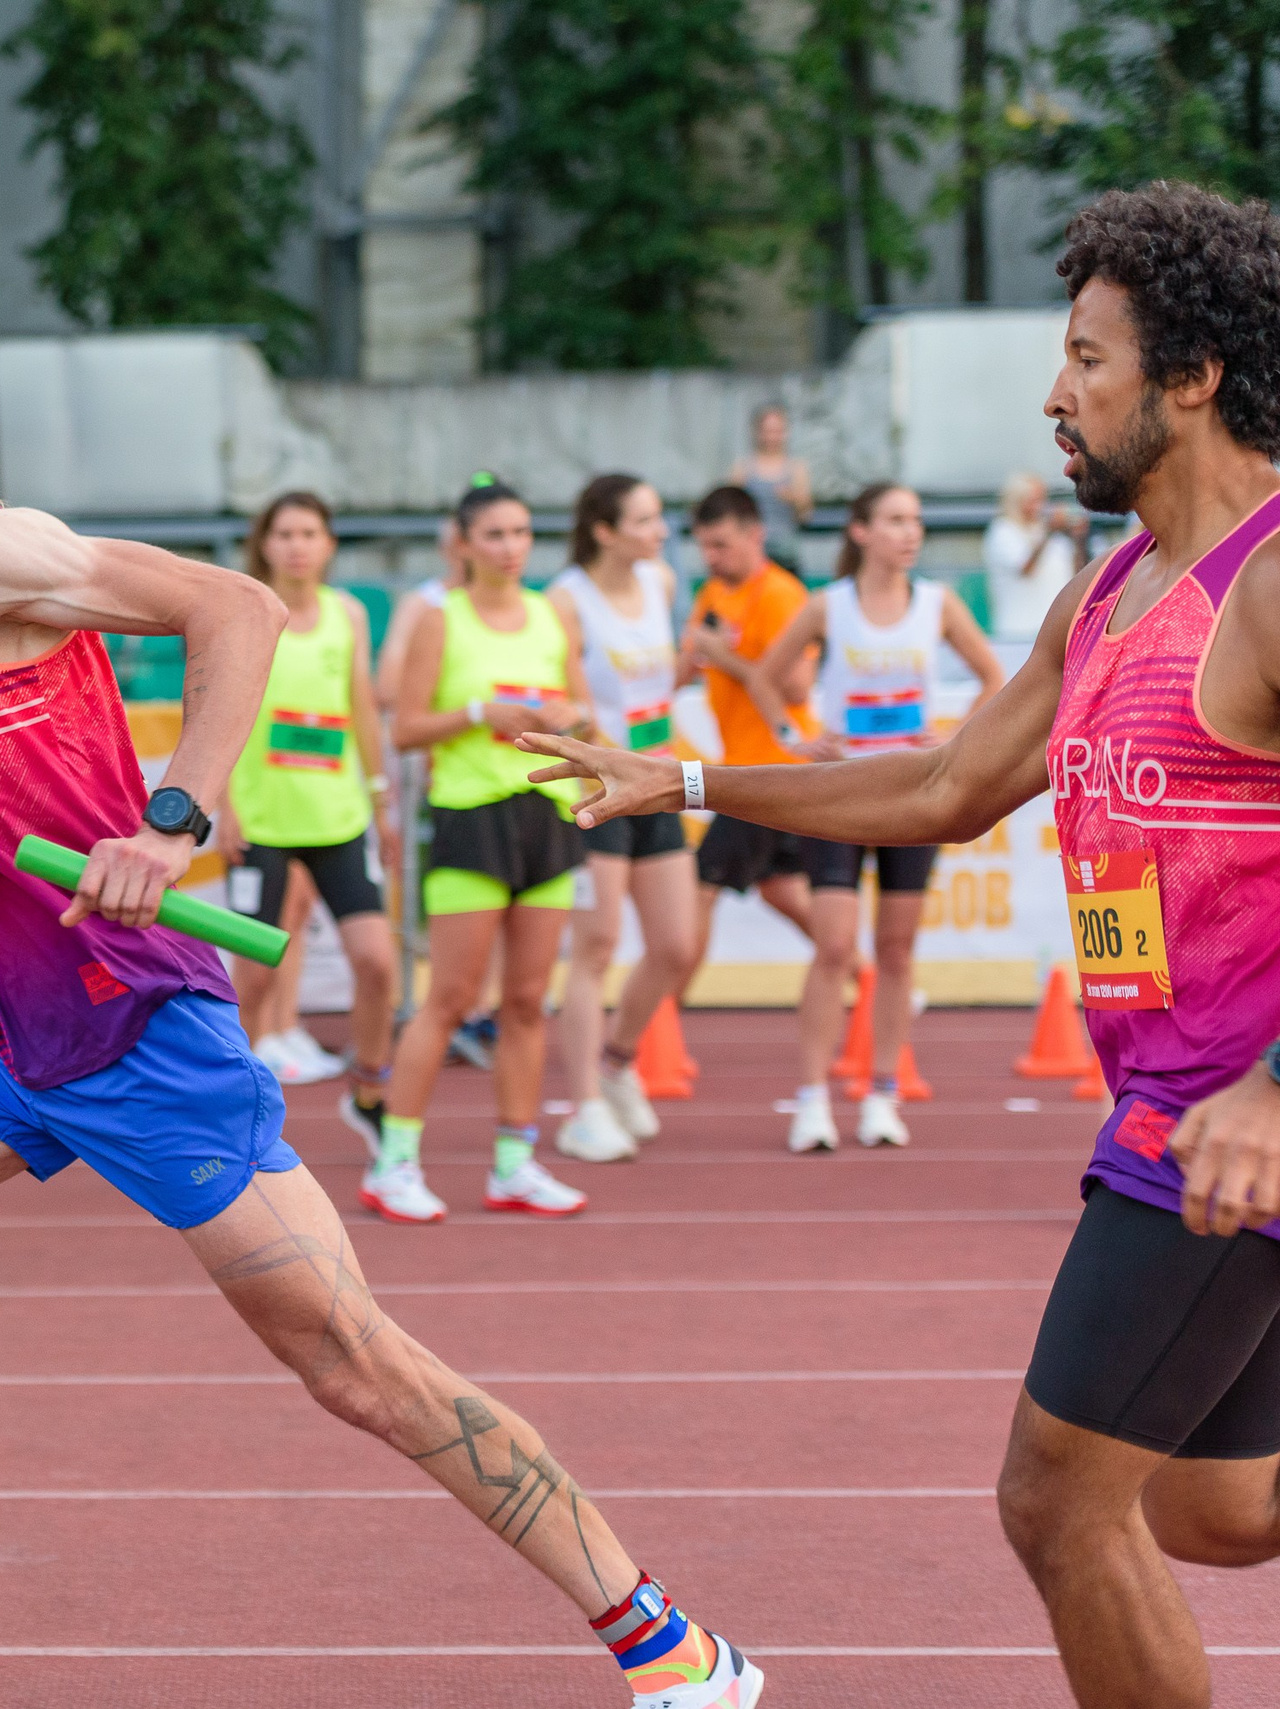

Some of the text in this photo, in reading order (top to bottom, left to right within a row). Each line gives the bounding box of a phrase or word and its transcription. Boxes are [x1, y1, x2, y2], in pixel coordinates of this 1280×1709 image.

[687, 775, 699, 796] 217
[1078, 908, 1148, 959] 206 2
[1112, 985, 1139, 1000] метров
[190, 1157, 226, 1185] SAXX
